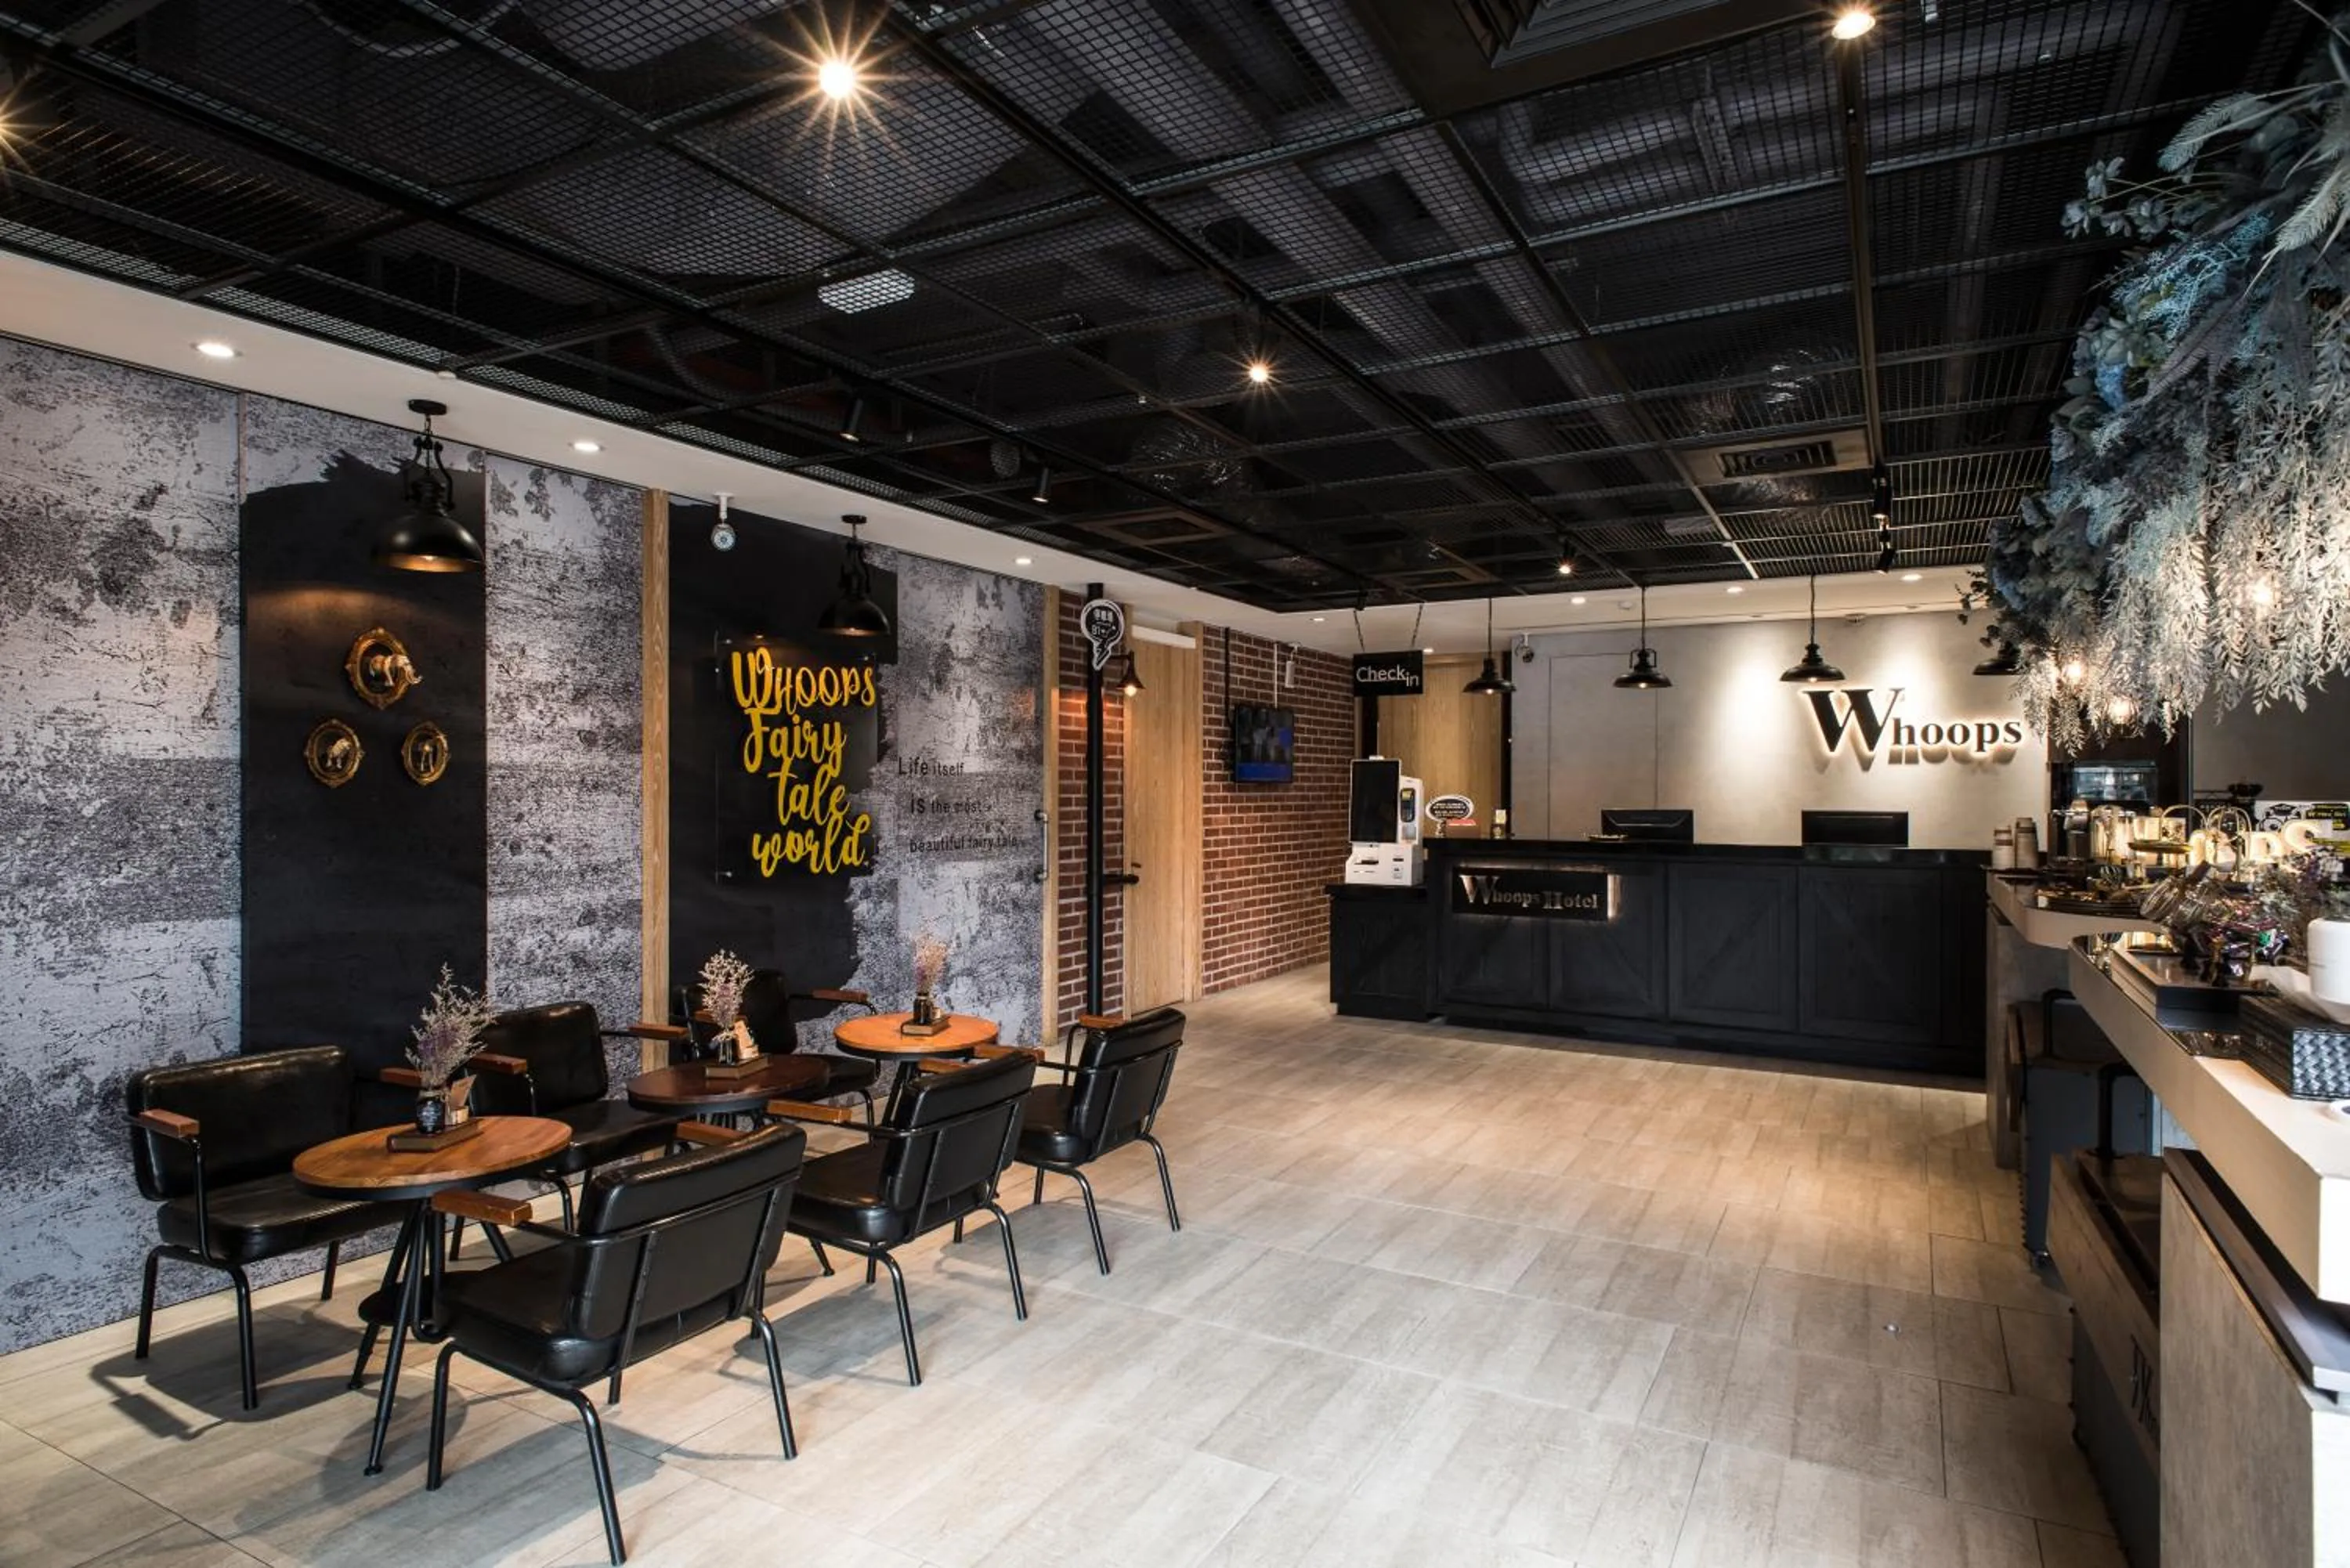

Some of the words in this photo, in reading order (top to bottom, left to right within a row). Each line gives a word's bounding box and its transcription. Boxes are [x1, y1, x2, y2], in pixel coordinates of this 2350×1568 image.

[1355, 664, 1407, 682] Check
[1406, 671, 1419, 687] in
[1802, 687, 2023, 752] Whoops
[744, 706, 847, 778] Fairy
[898, 757, 929, 775] Life
[933, 761, 964, 777] itself
[768, 757, 850, 826] tale
[930, 798, 950, 814] the
[953, 800, 982, 814] most
[909, 835, 964, 852] beautiful
[967, 835, 993, 851] fairy
[1459, 874, 1541, 907] Whoops
[1542, 891, 1598, 909] Hotel
